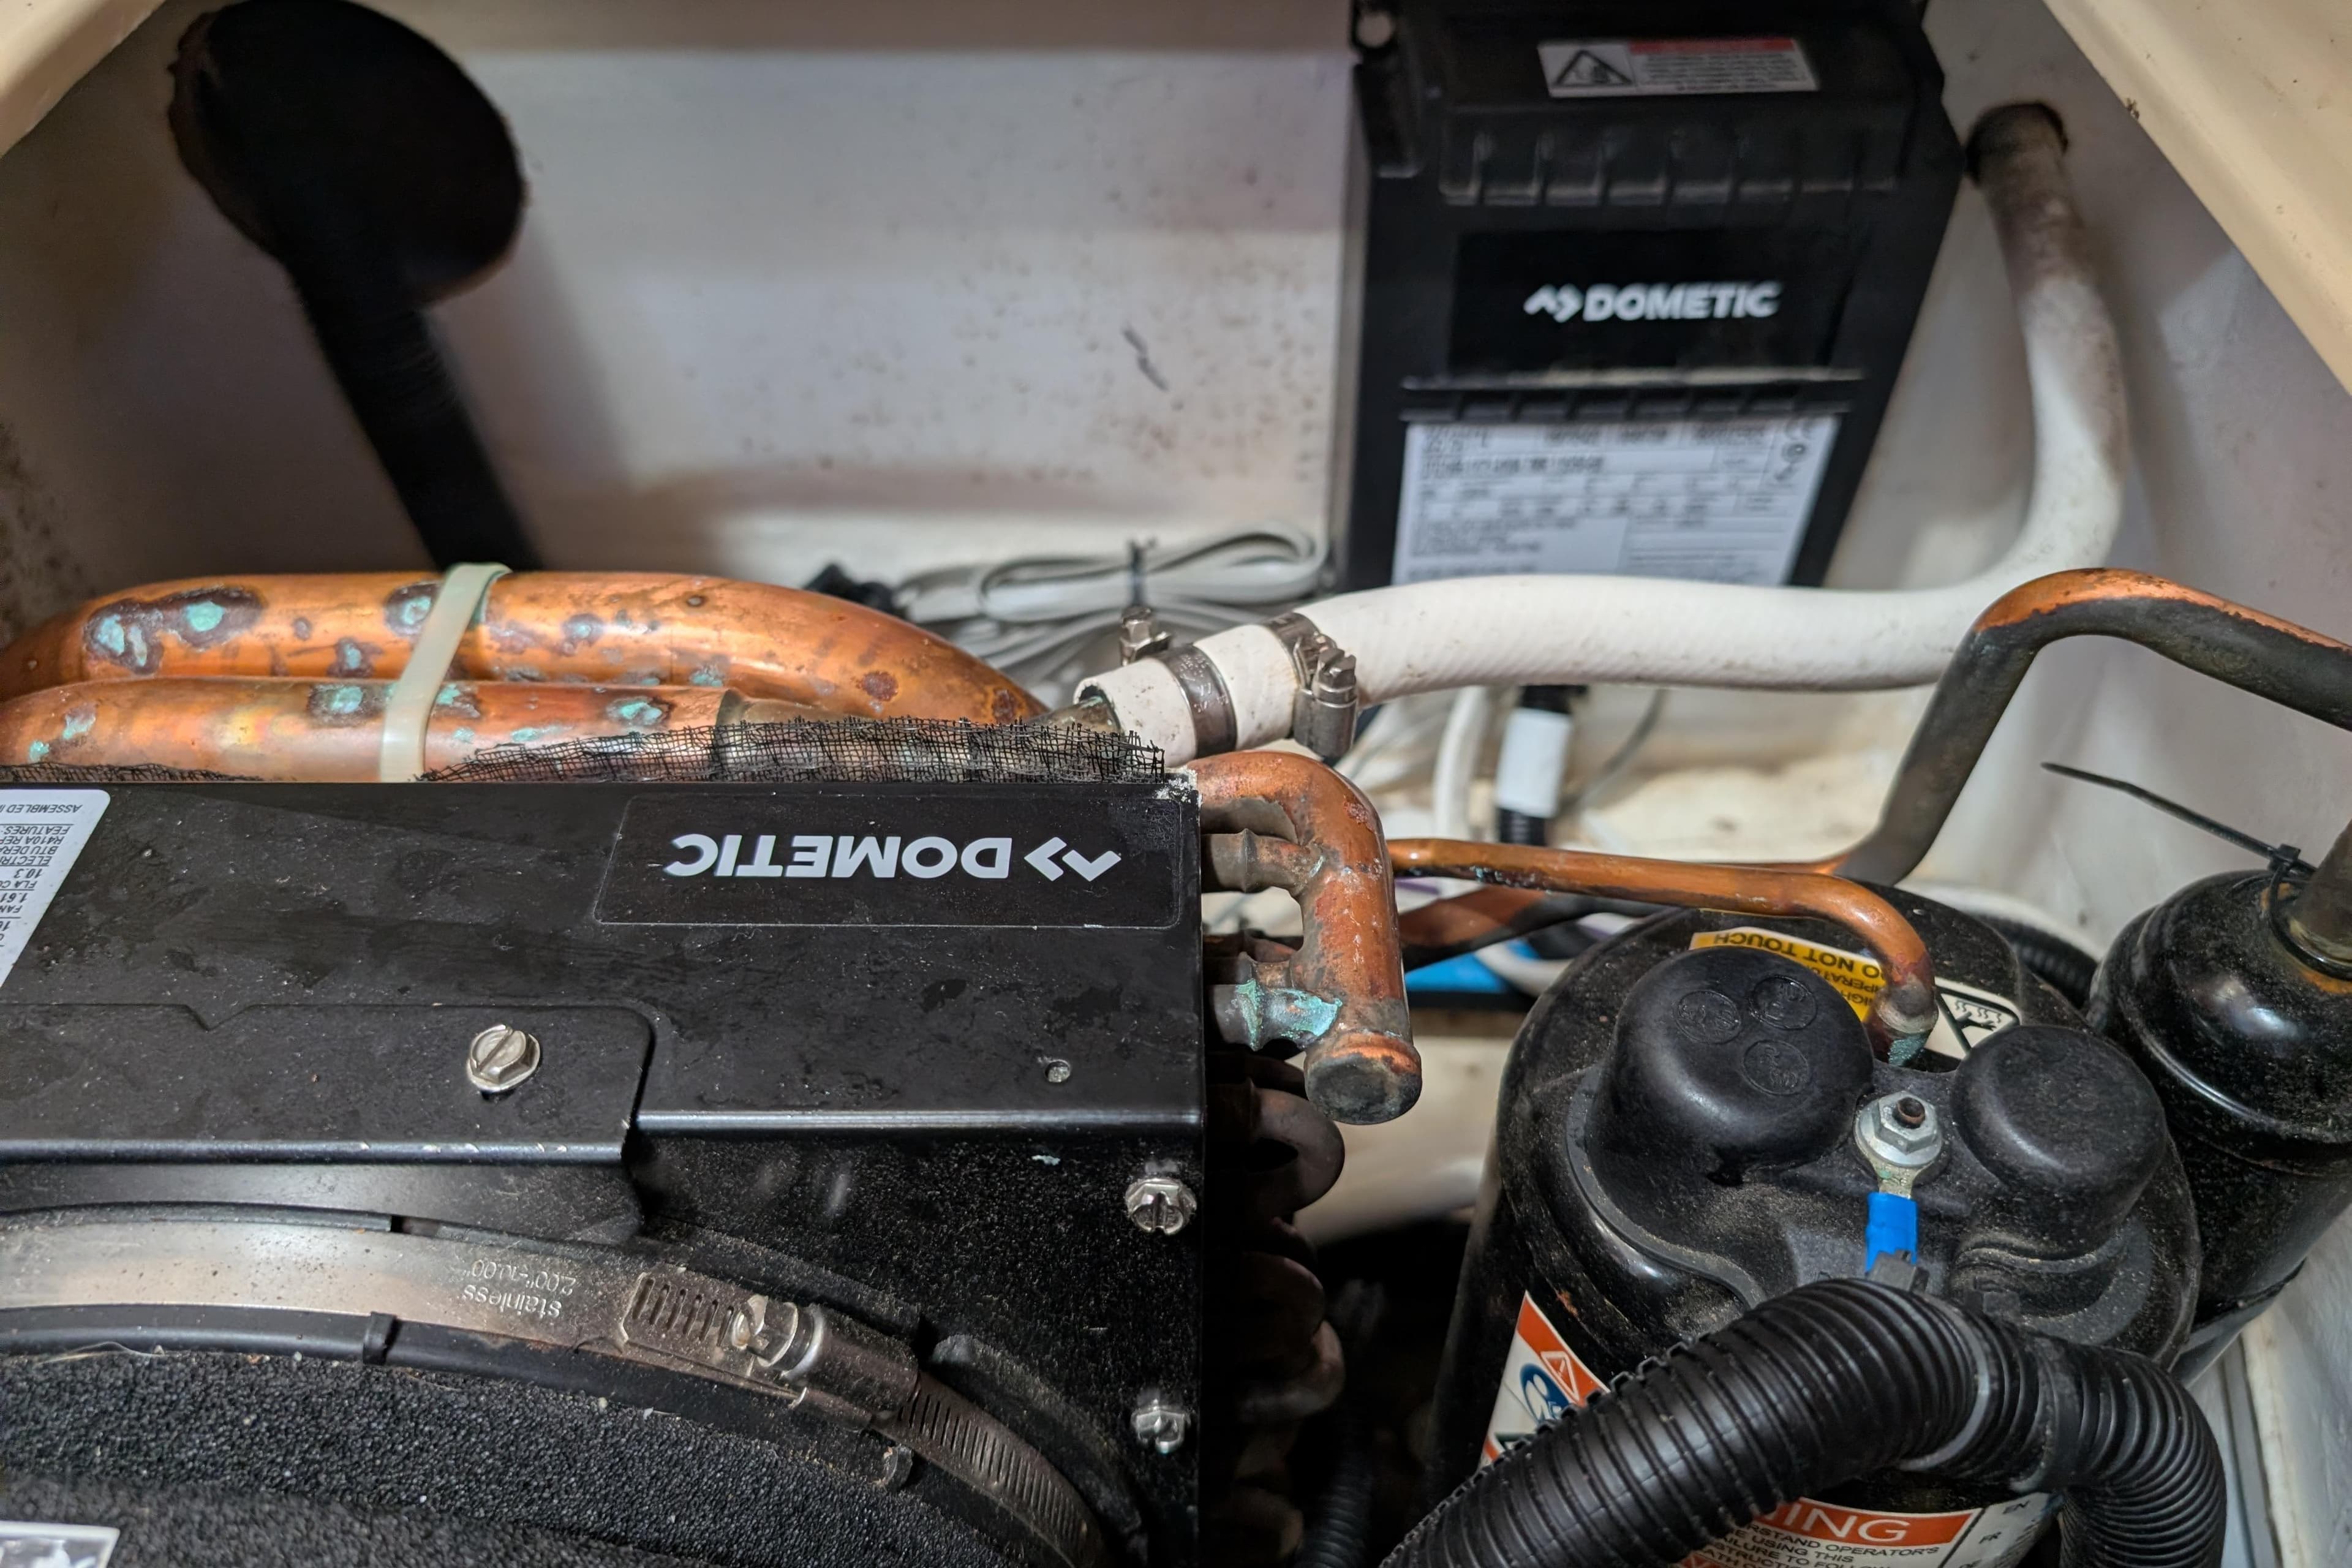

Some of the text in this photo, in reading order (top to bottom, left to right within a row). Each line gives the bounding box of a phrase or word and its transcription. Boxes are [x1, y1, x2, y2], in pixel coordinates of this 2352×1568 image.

[1583, 281, 1782, 322] DOMETIC
[6, 804, 83, 813] ASSEMBLED
[25, 836, 65, 845] R410A
[29, 846, 59, 854] BTU
[663, 833, 1012, 879] DOMETIC
[13, 868, 43, 878] 10.3
[1714, 933, 1884, 978] O NOT TOUCH
[464, 1284, 562, 1319] stainless
[1763, 1503, 1911, 1542] ING
[1752, 1535, 1809, 1556] USING
[1814, 1550, 1855, 1563] THIS
[1825, 1544, 1940, 1556] OPERATOR'S
[1785, 1554, 1810, 1566] TO
